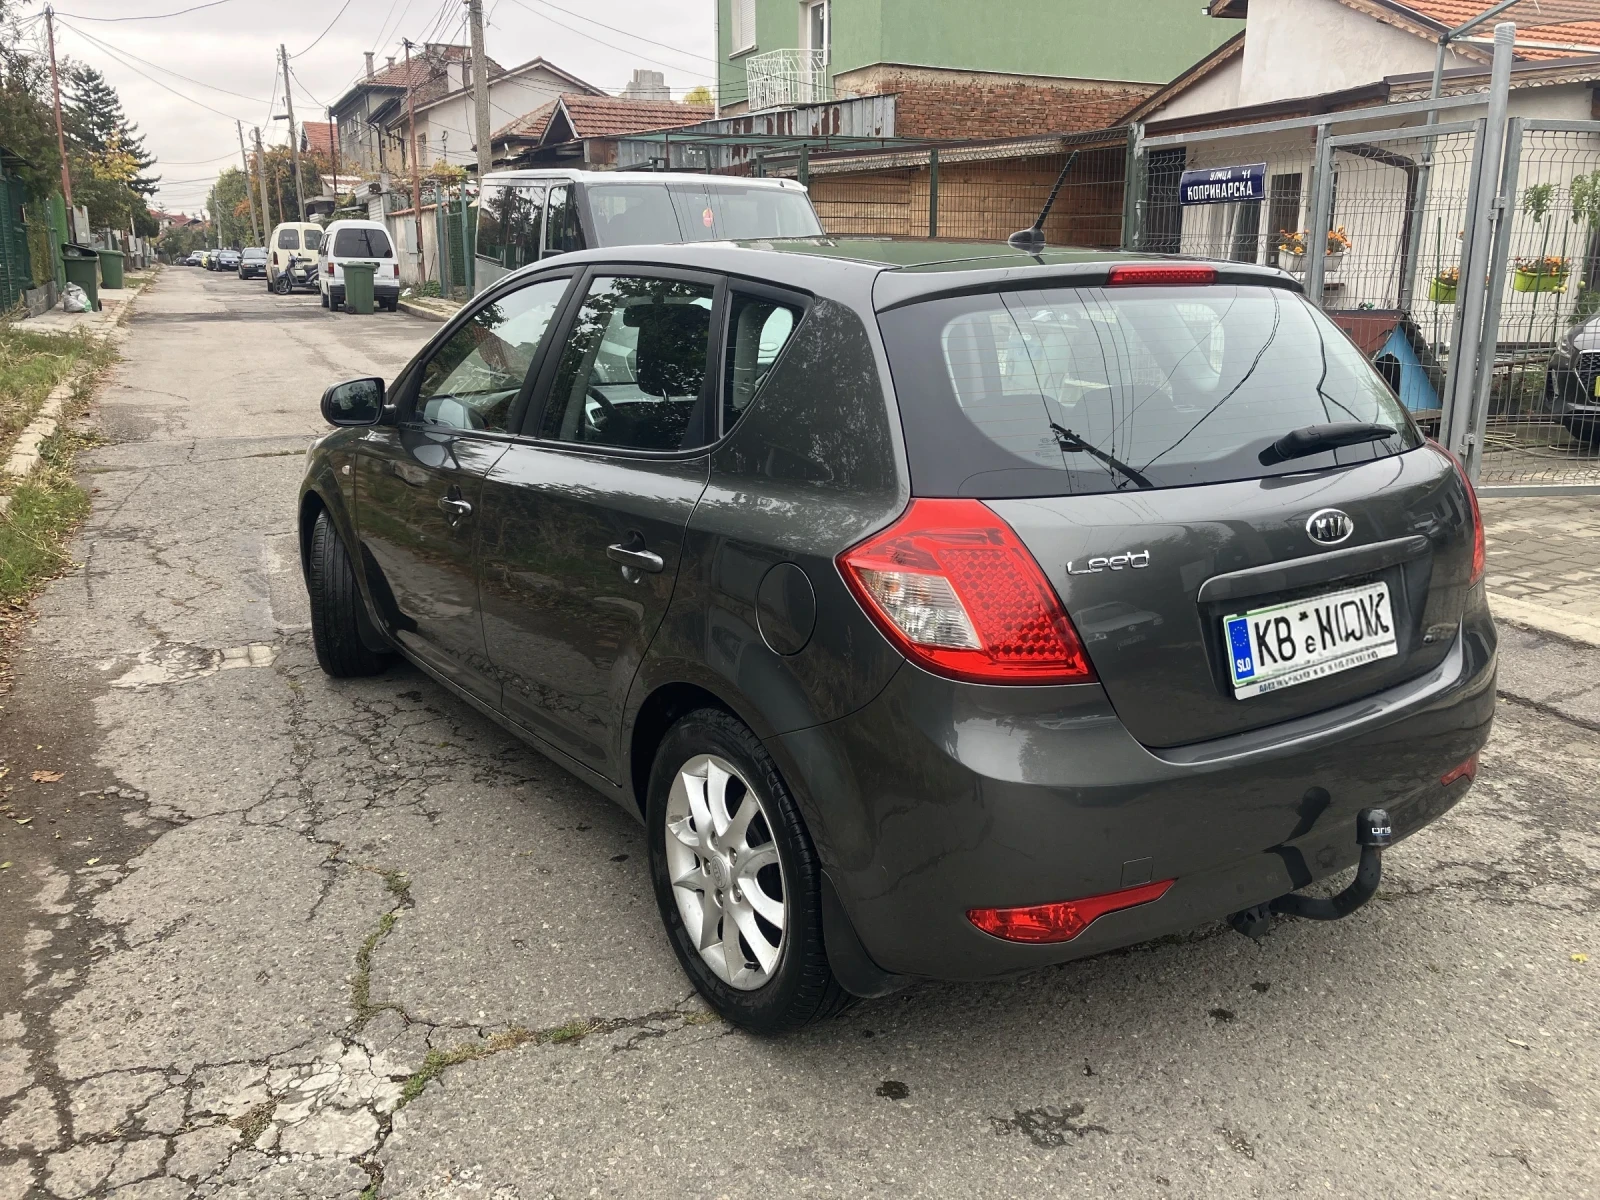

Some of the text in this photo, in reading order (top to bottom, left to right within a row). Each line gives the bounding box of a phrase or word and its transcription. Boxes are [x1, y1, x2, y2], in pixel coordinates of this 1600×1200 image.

[1209, 170, 1232, 181] УЛИЦА
[1187, 181, 1253, 201] КОПРИНАРСКА
[1254, 616, 1297, 667] KB
[1237, 656, 1251, 673] SLO
